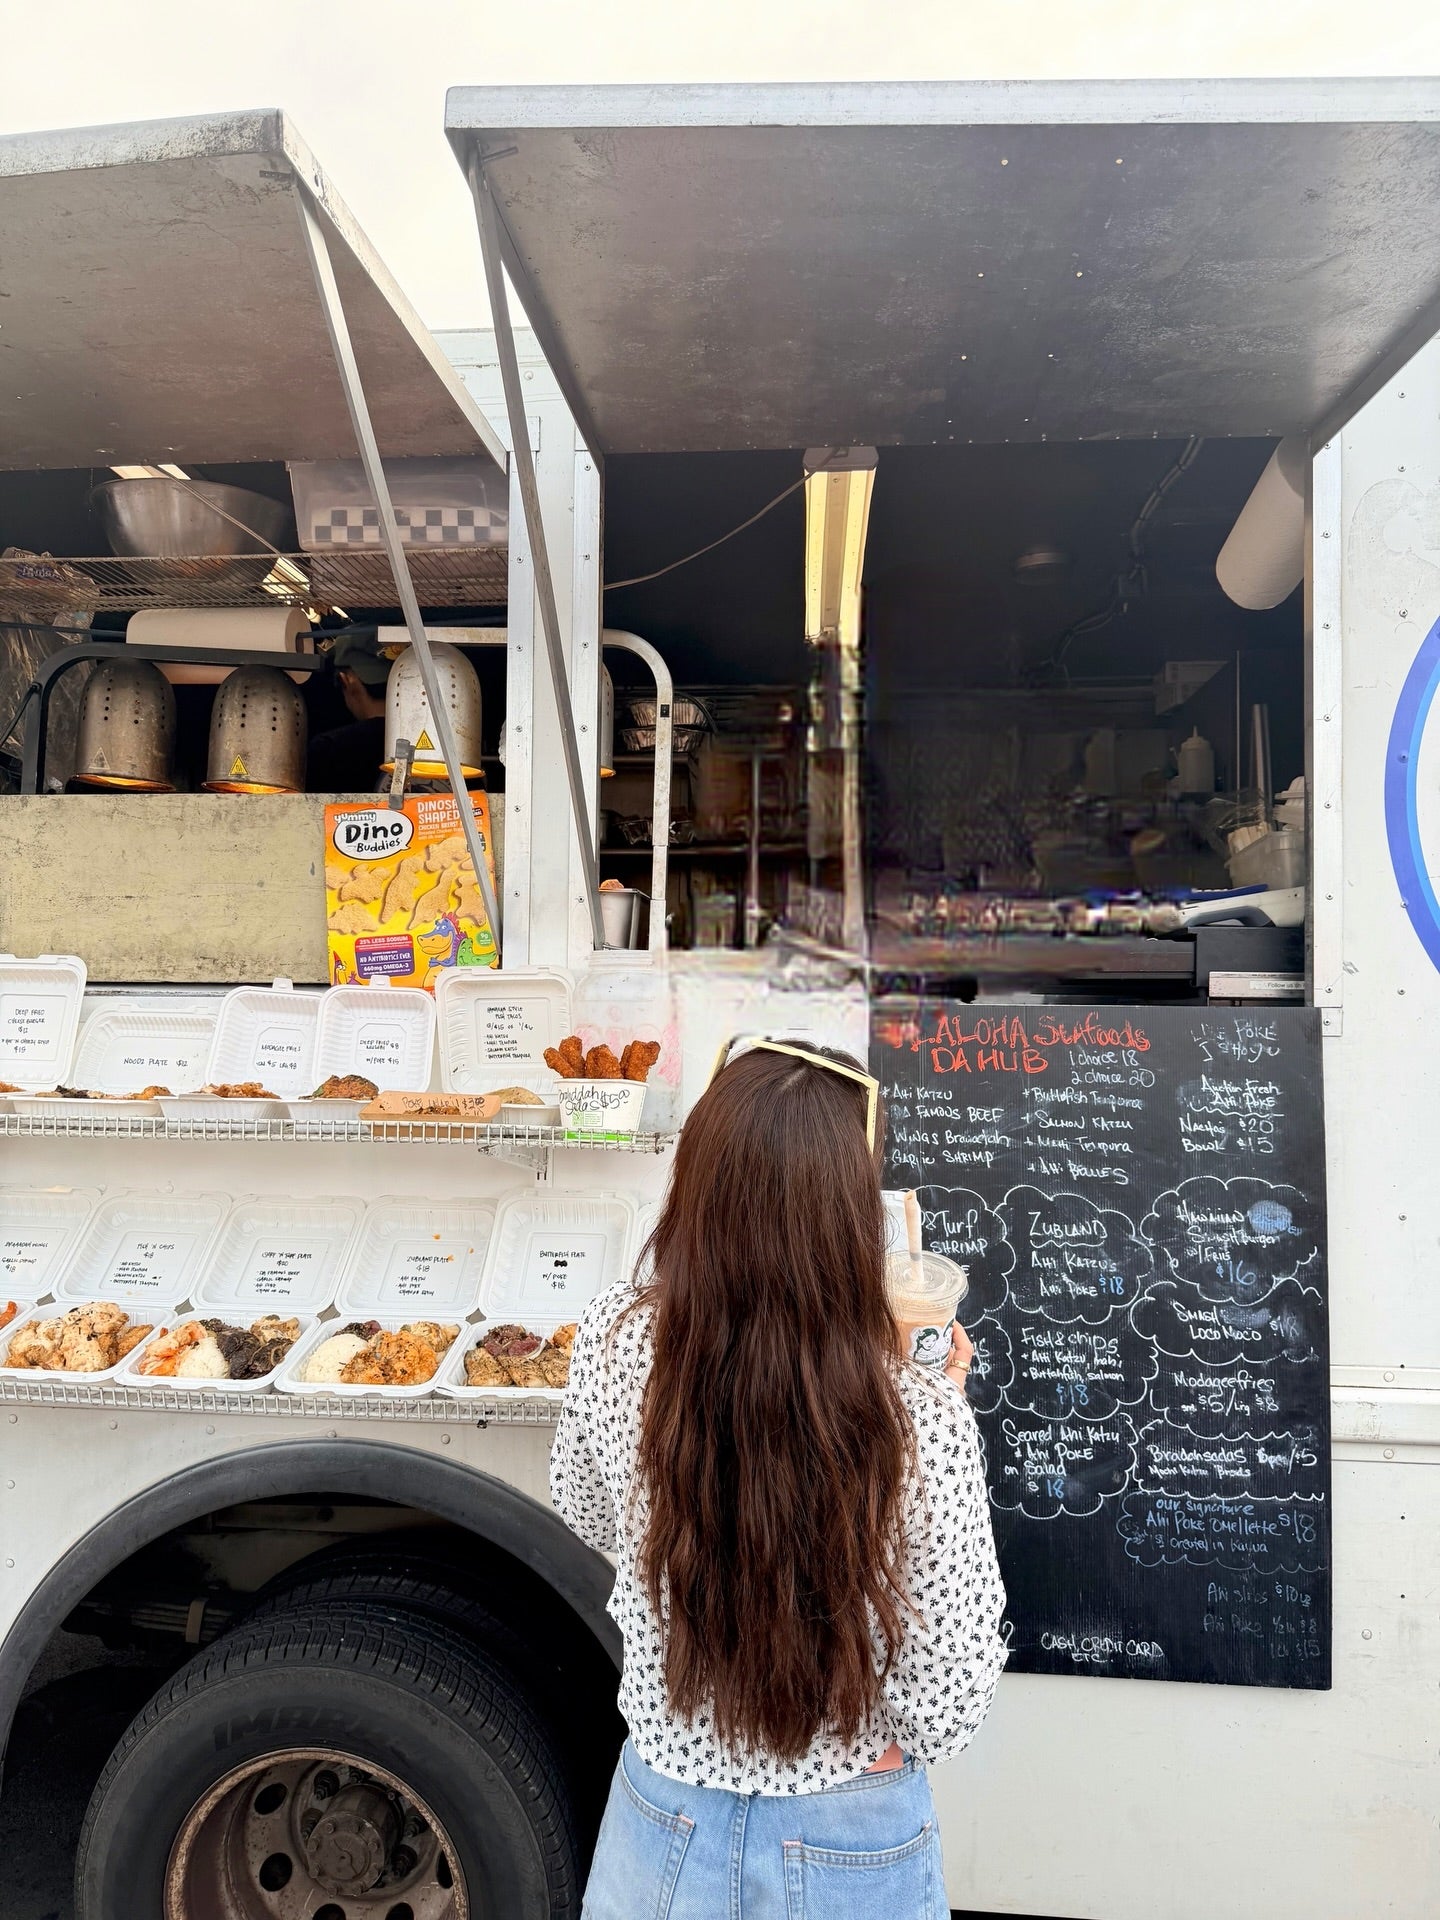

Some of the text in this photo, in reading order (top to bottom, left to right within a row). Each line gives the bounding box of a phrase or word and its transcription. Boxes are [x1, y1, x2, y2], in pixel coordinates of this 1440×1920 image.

[334, 811, 377, 823] yummy
[419, 809, 460, 825] SHAPED
[345, 822, 403, 844] Dino
[356, 838, 401, 853] Buddies
[935, 1014, 1030, 1049] ALOHA
[931, 1047, 1049, 1074] DA HUB
[967, 1106, 1004, 1123] BEEF
[942, 1150, 995, 1168] SHRIMP
[929, 1237, 988, 1258] SHRIMP
[1215, 1260, 1257, 1285] $16
